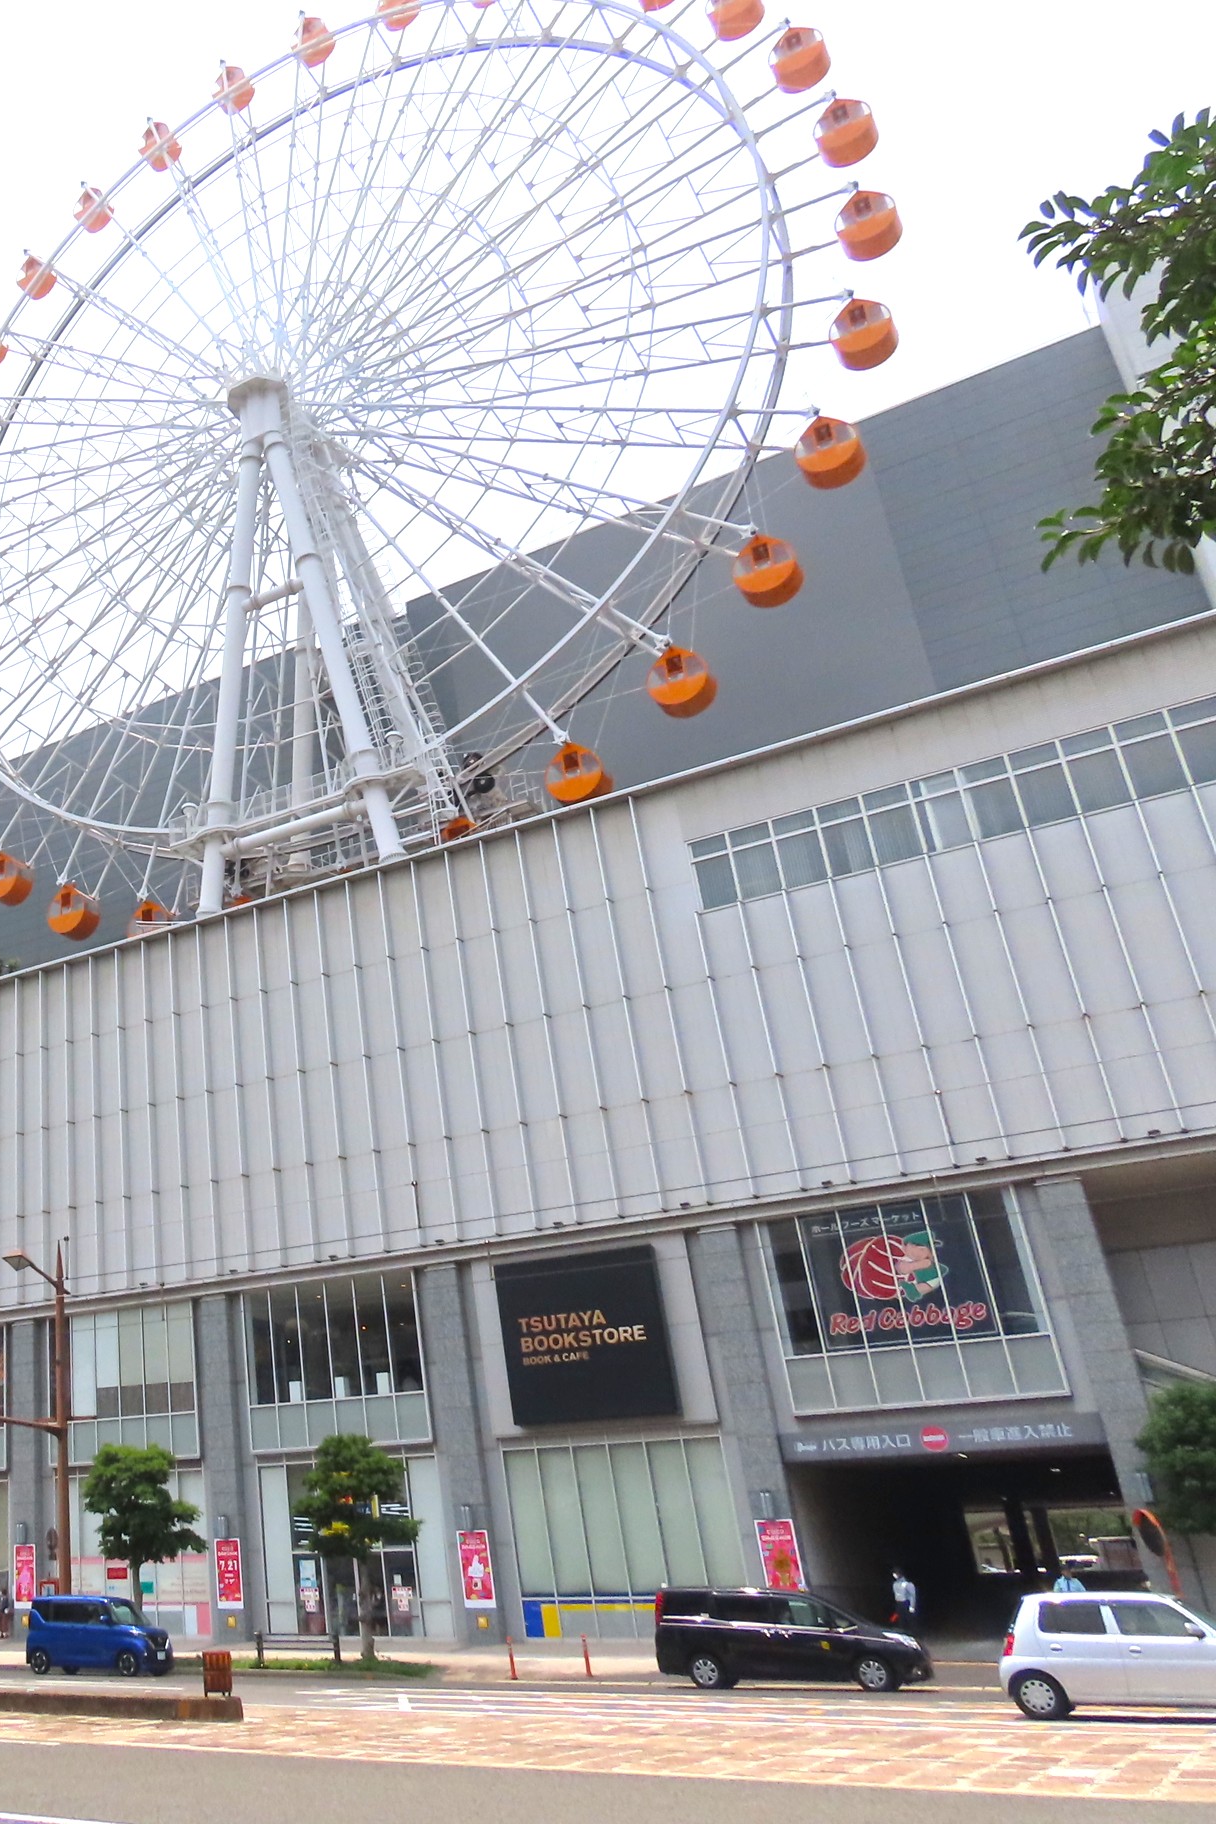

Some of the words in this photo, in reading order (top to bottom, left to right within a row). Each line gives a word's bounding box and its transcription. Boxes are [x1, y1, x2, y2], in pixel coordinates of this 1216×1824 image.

[517, 1309, 607, 1334] TSUTAYA
[829, 1310, 876, 1336] Red
[878, 1301, 987, 1330] Cabbage
[523, 1355, 552, 1366] BOOK
[553, 1354, 561, 1362] &
[562, 1351, 589, 1362] CAFE
[822, 1433, 912, 1451] バス専用入口
